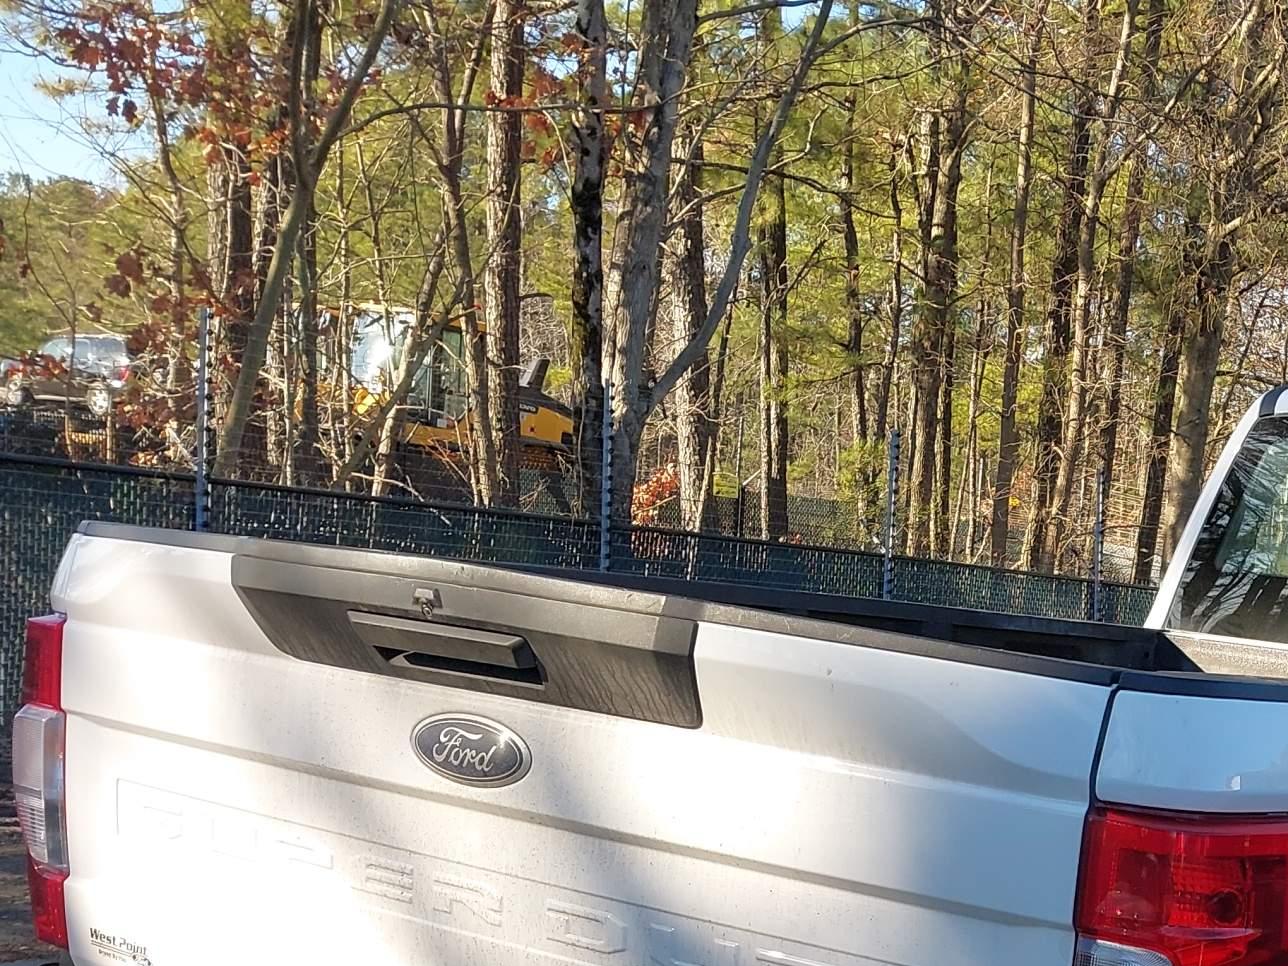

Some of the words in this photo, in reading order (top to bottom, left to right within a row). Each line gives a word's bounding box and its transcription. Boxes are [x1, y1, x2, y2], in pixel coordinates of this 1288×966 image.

[432, 726, 497, 772] Ford
[89, 927, 117, 947] West
[118, 936, 148, 956] Point
